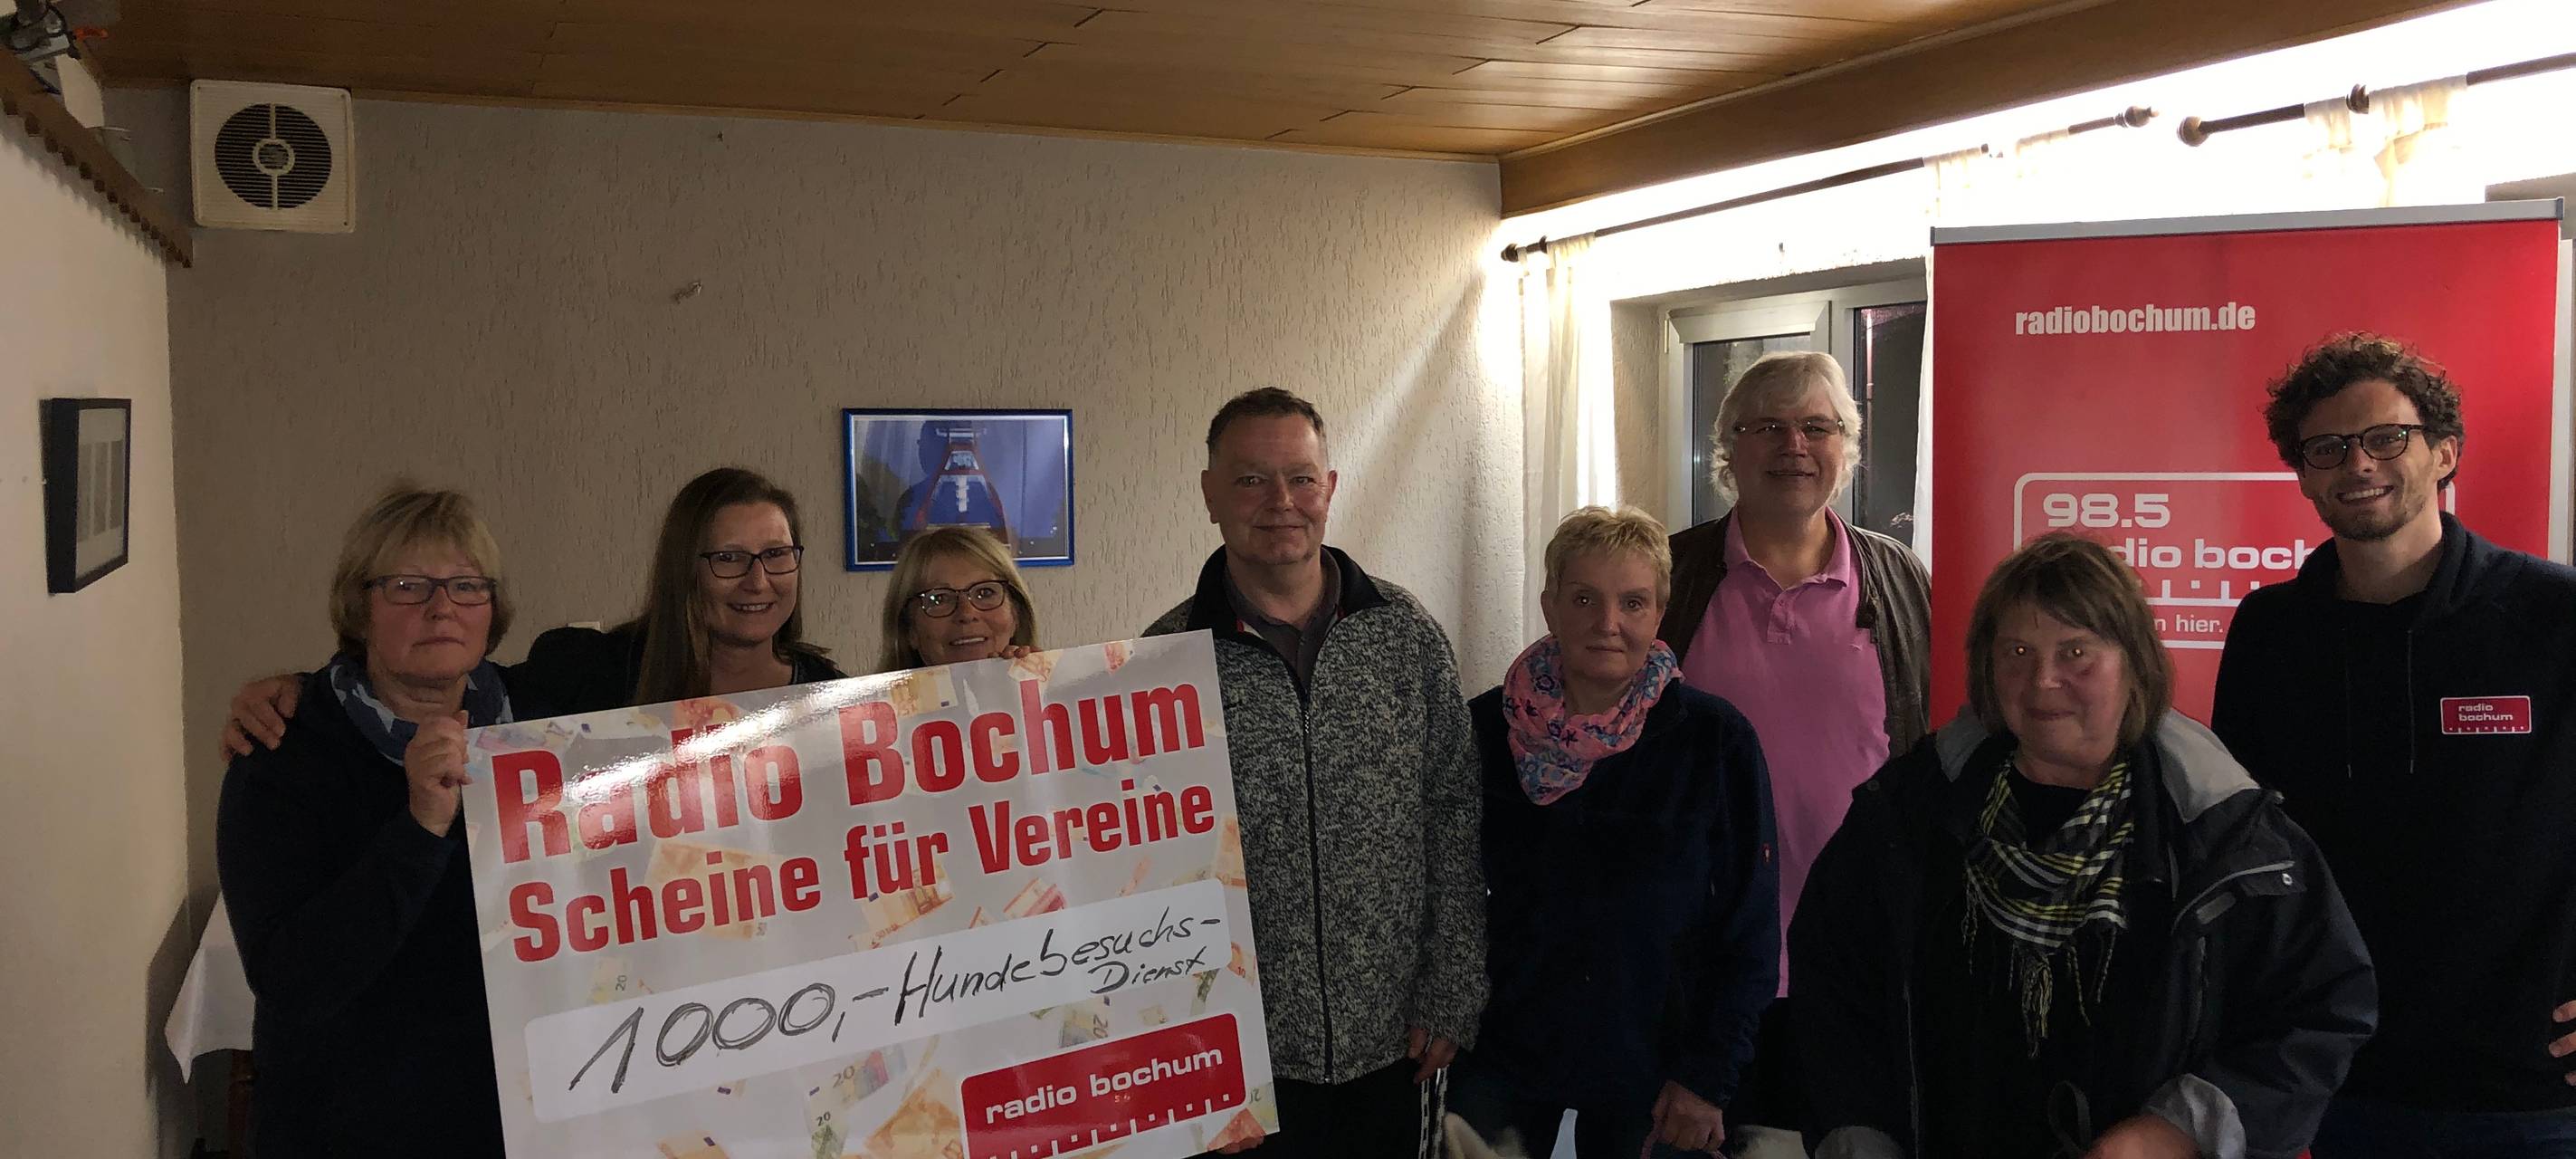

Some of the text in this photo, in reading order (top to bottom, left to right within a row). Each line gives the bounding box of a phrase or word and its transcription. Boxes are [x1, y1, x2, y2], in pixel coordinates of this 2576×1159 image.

[2015, 302, 2256, 335] radiobochum.de
[2042, 493, 2171, 528] 98.5
[2176, 615, 2224, 633] hier.
[2458, 704, 2494, 712] radio
[2458, 714, 2514, 722] bochum
[491, 679, 1206, 863] Radio Bochum
[509, 779, 1215, 963] Scheine für Vereine
[1087, 946, 1207, 993] Dienst
[833, 1065, 855, 1087] 20
[985, 1048, 1223, 1124] radio bochum
[816, 1112, 832, 1127] 20
